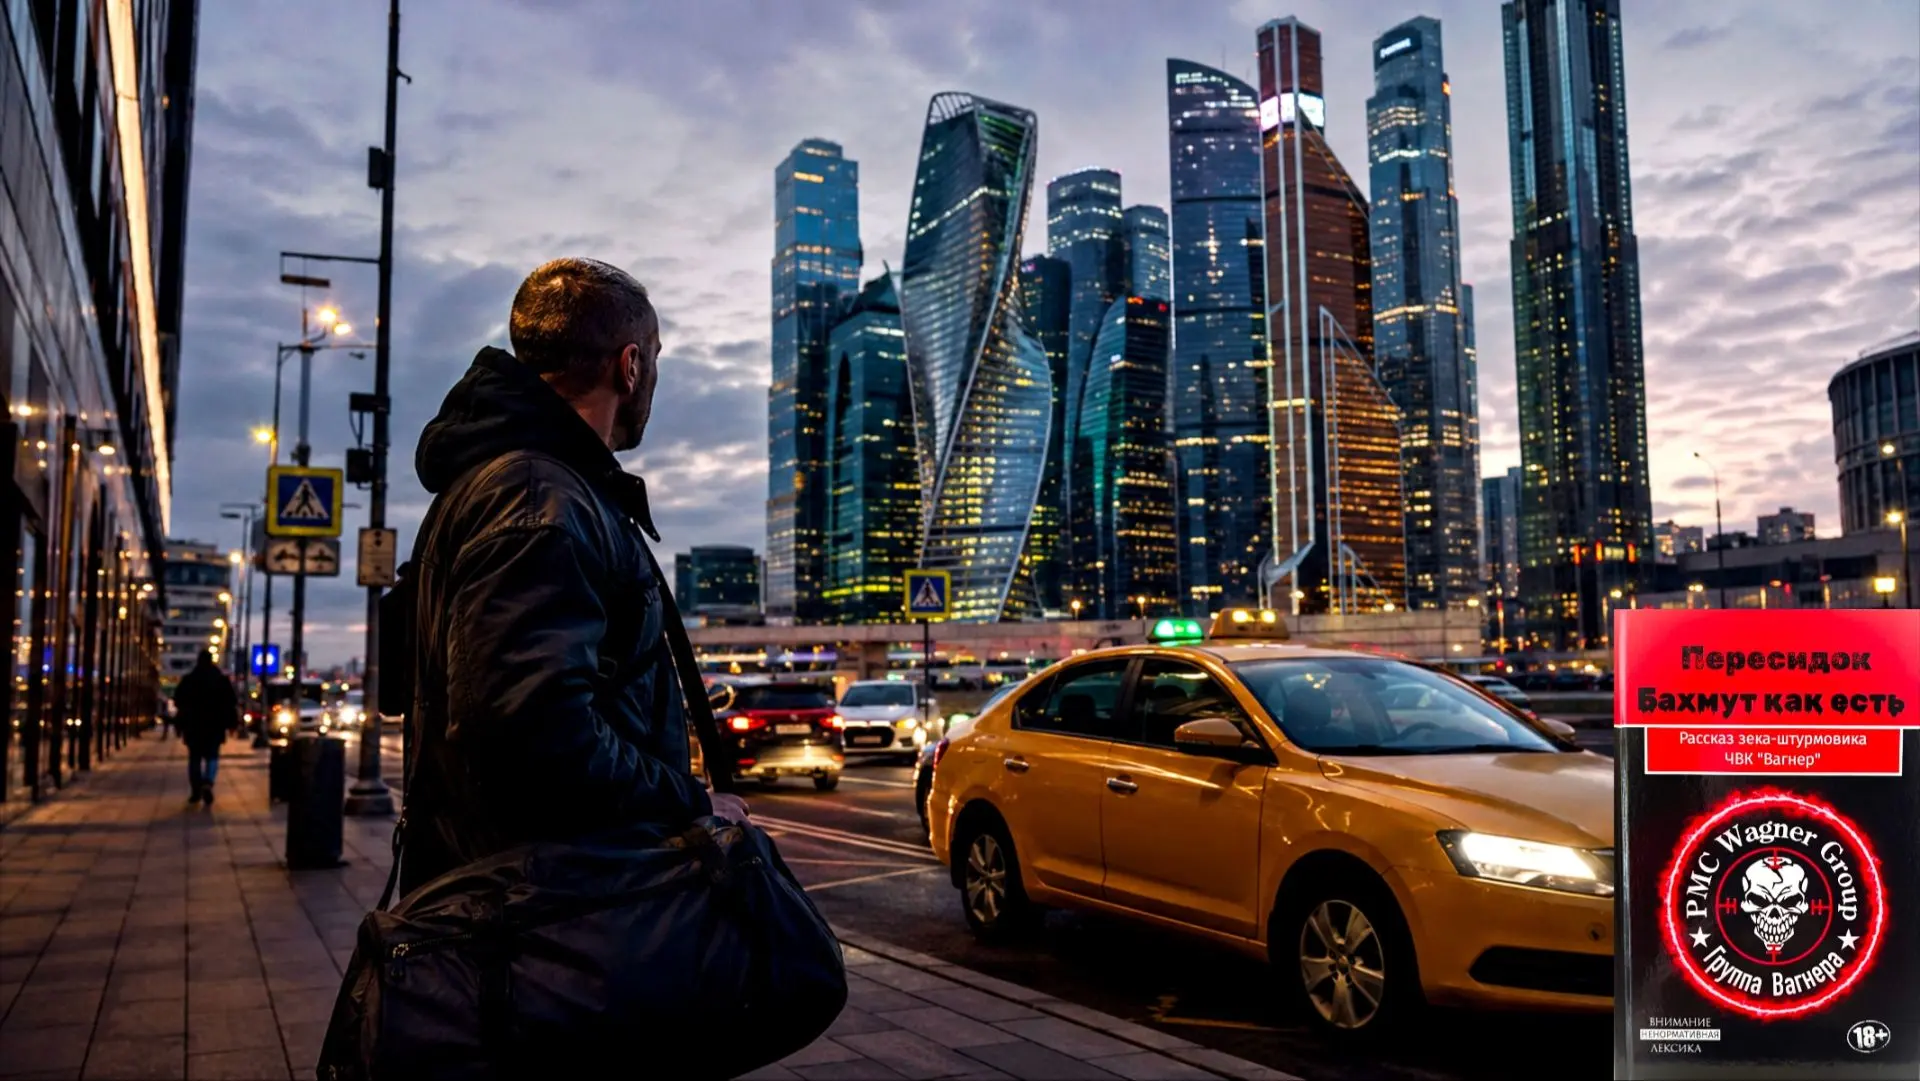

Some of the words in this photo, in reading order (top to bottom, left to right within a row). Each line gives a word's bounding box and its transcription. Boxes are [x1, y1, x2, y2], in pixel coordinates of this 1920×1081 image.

[1681, 645, 1871, 676] Пересидок
[1637, 687, 1758, 718] Бахмут
[1764, 693, 1823, 717] как
[1830, 693, 1905, 717] есть
[1679, 732, 1734, 745] Рассказ
[1738, 733, 1867, 749] зека-штурмовика
[1724, 753, 1753, 765] ЧВК
[1757, 753, 1821, 769] "Вагнер"
[1686, 852, 1720, 918] PMC
[1715, 821, 1818, 854] Wagner
[1820, 841, 1858, 921] Group
[1703, 945, 1762, 995] Группа
[1772, 951, 1845, 997] Вагнера
[1650, 1017, 1711, 1028] ВНИМАНИЕ
[1641, 1029, 1720, 1039] НЕНОРМАТИВНАЯ
[1853, 1026, 1888, 1048] 18+
[1650, 1043, 1702, 1053] ЛЕКСИКА
